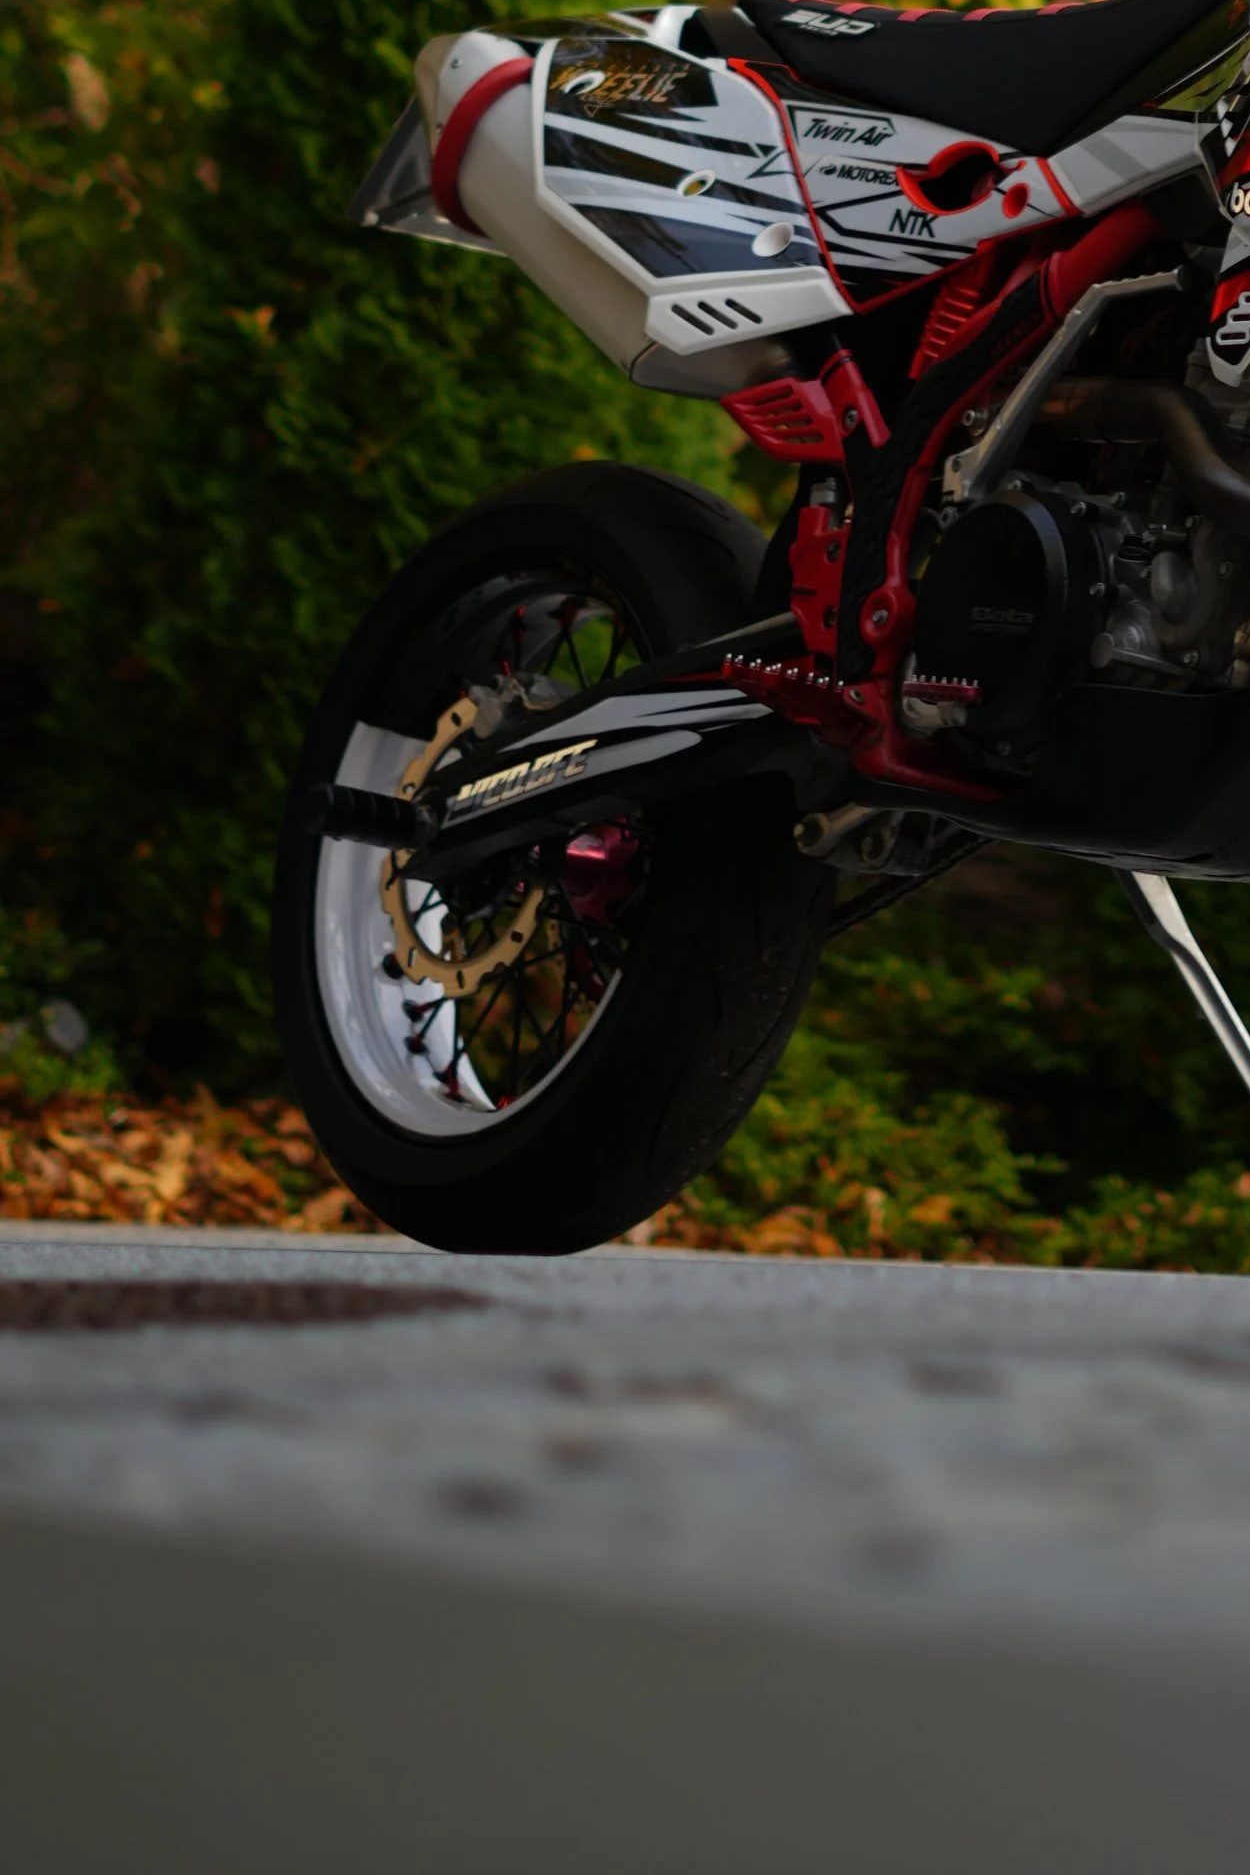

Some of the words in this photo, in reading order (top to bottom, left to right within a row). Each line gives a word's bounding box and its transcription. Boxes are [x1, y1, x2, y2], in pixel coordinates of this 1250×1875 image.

[803, 118, 857, 143] Twin
[851, 126, 894, 146] Air
[889, 208, 938, 238] NTK
